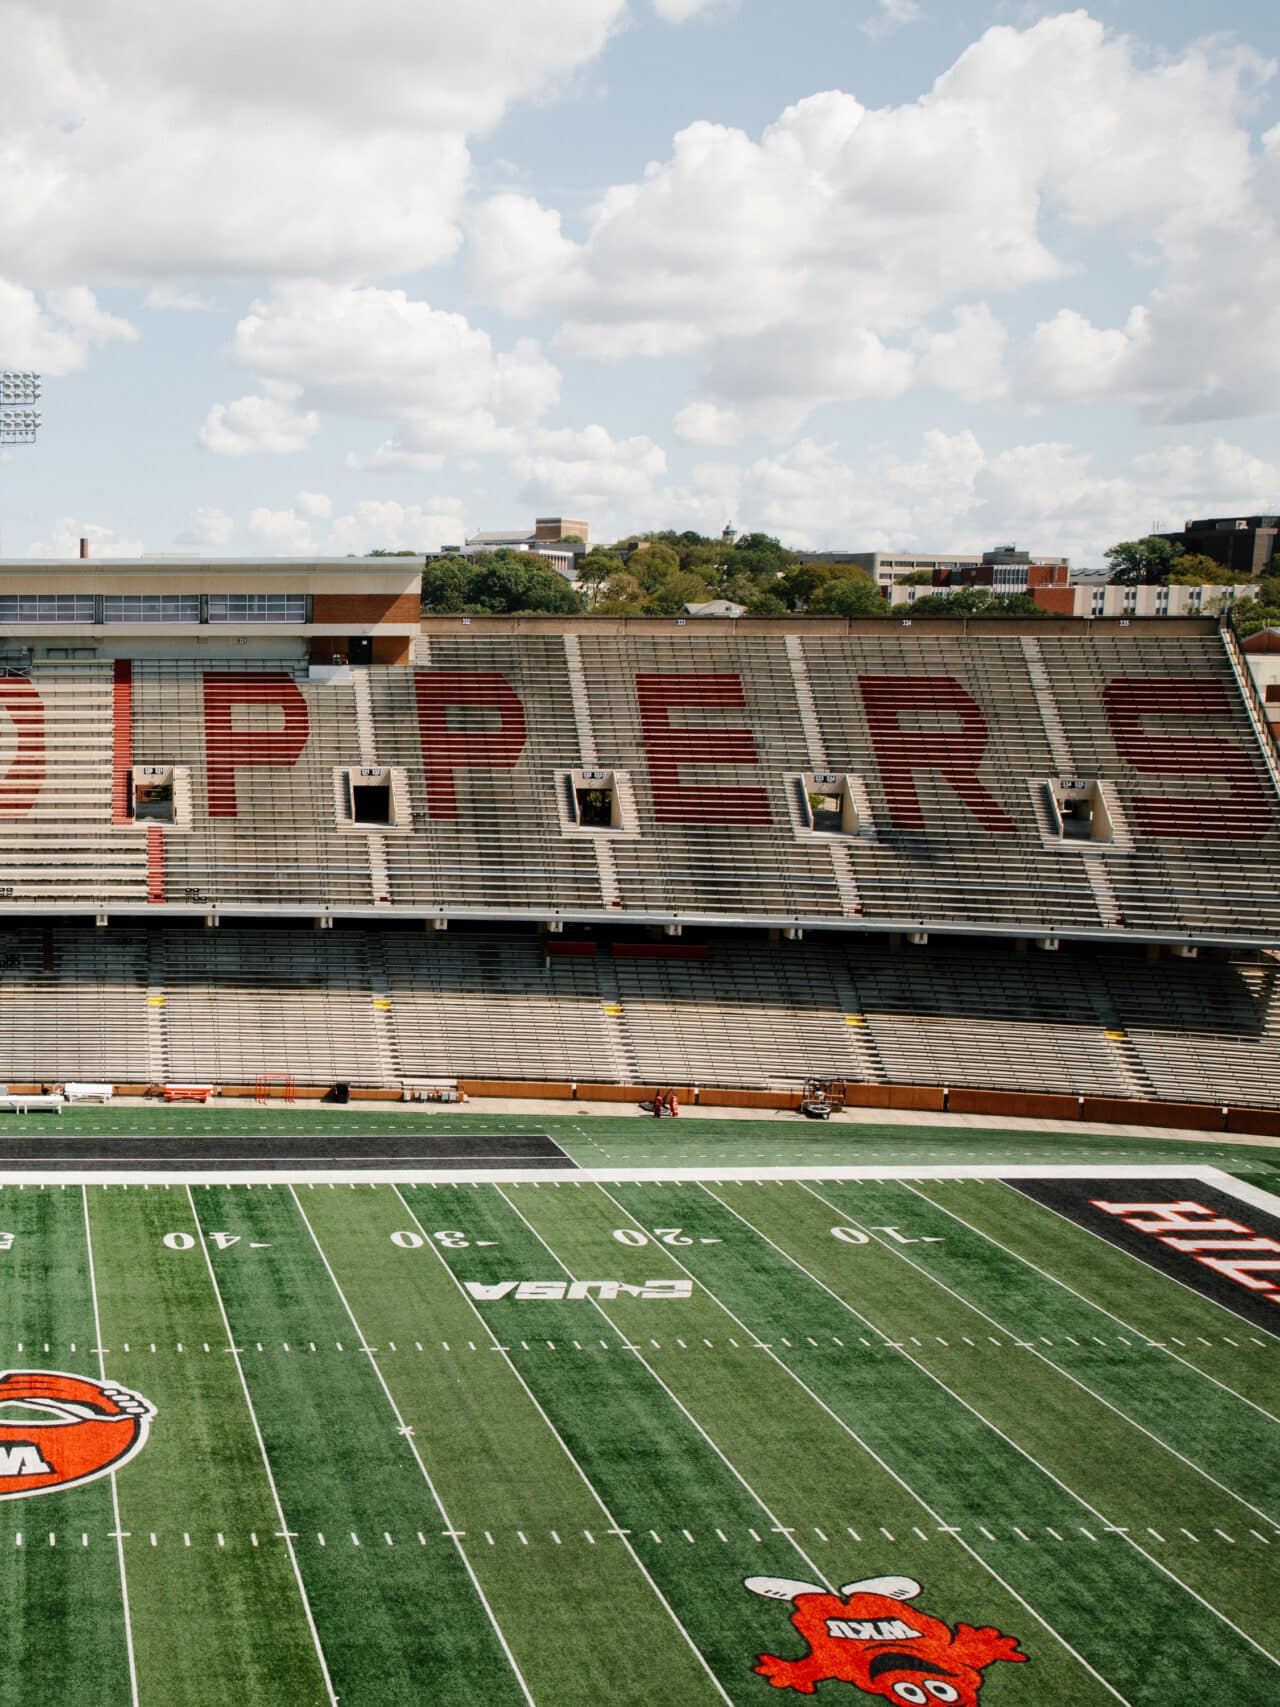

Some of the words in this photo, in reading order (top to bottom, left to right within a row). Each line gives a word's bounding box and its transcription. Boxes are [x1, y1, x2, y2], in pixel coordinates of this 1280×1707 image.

[162, 1232, 242, 1250] 40
[390, 1230, 470, 1249] 30
[612, 1228, 694, 1247] 20
[830, 1226, 919, 1245] 10
[827, 1619, 923, 1641] WKU
